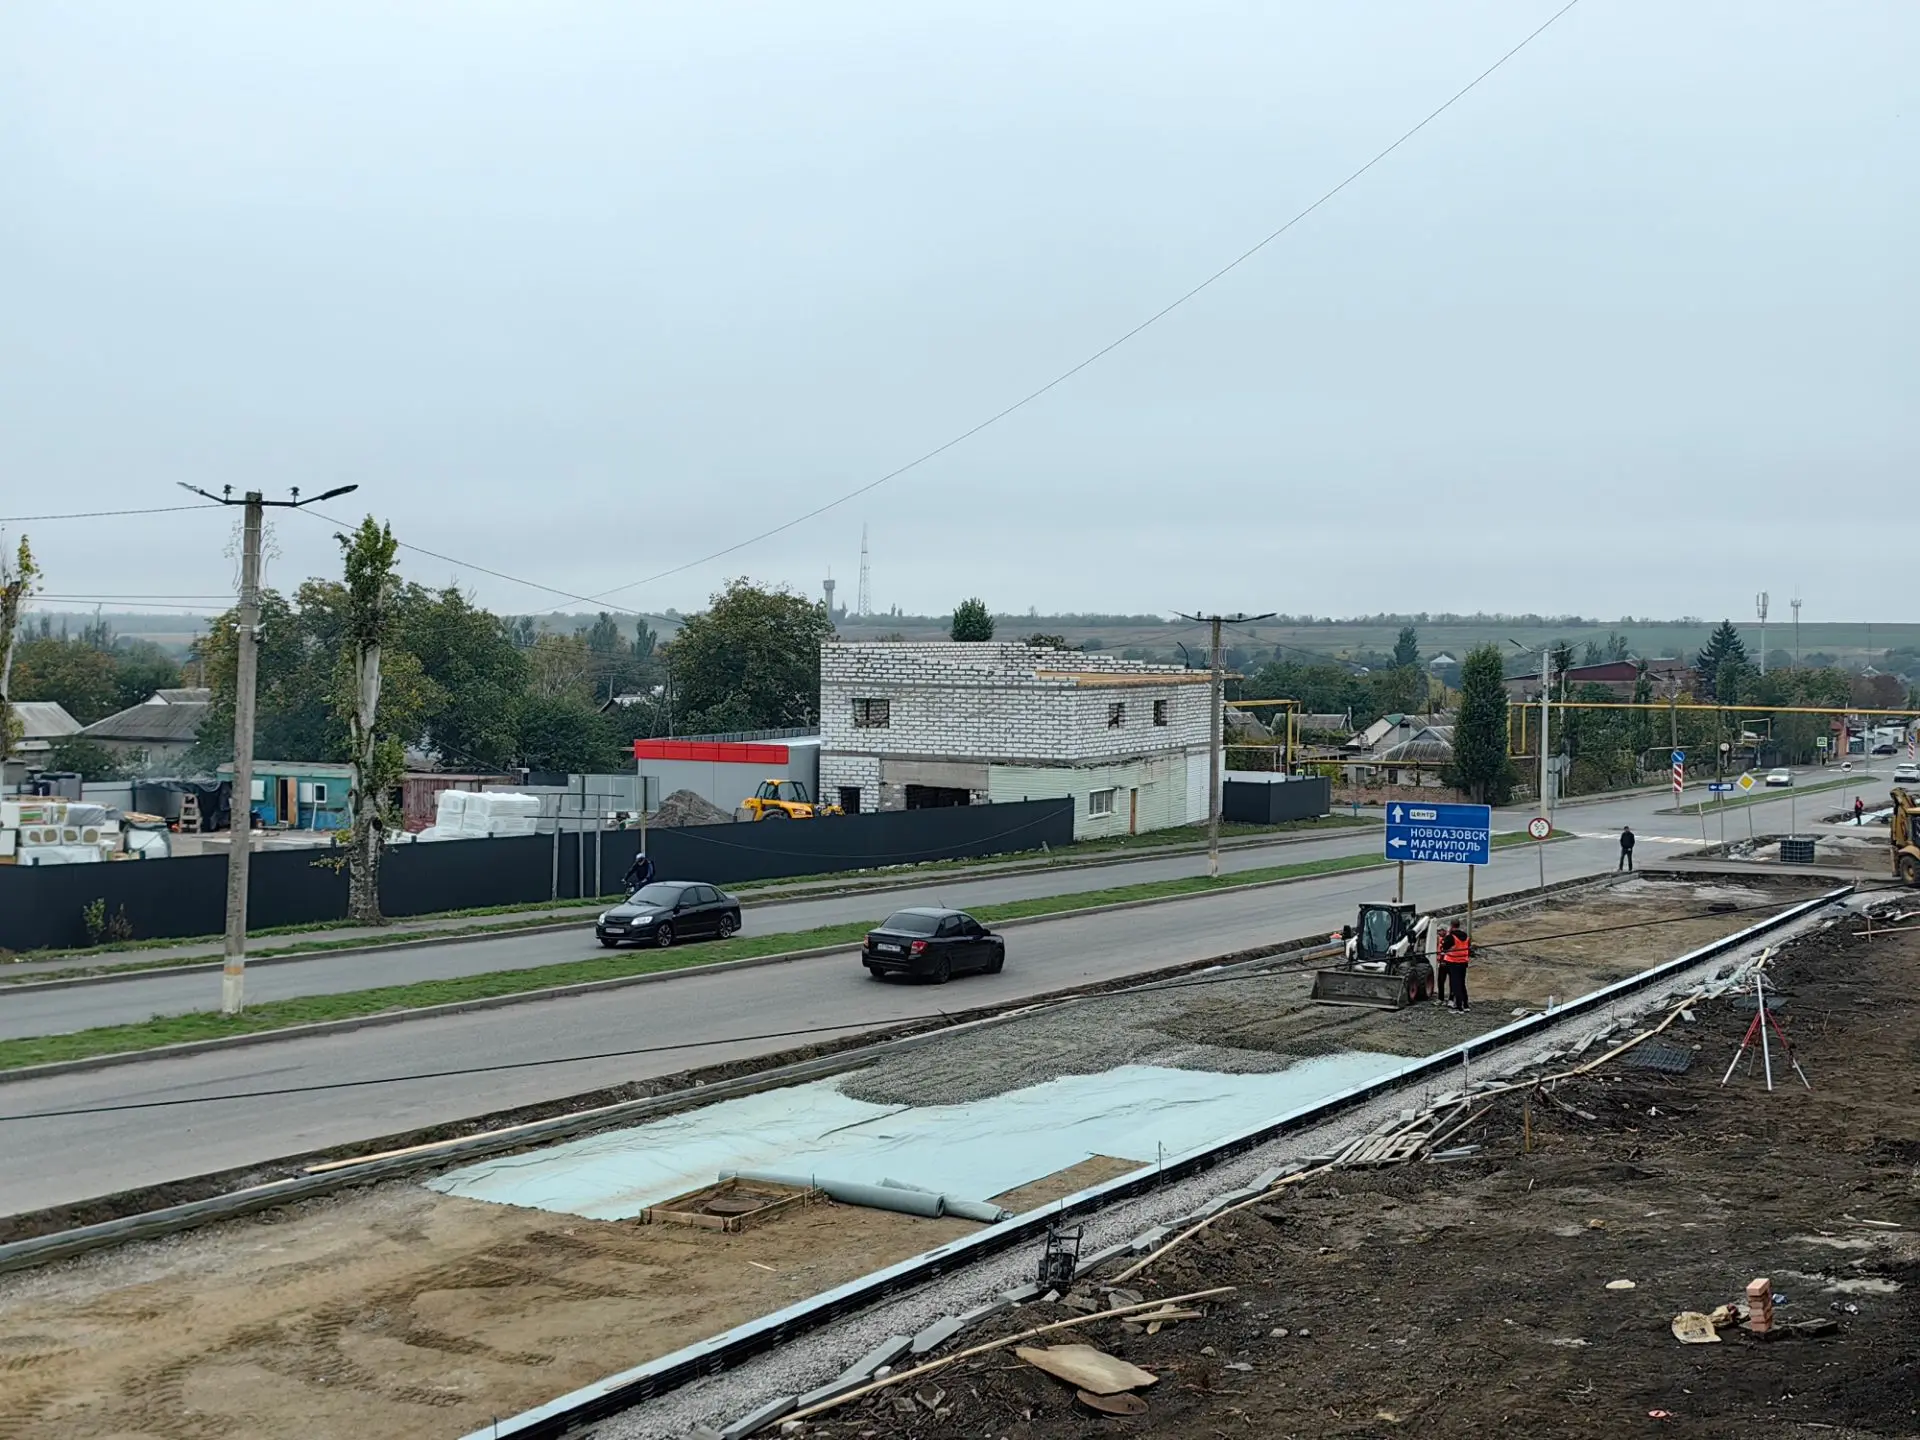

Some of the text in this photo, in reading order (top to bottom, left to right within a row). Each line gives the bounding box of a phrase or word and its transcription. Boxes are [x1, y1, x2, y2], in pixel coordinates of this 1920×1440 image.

[1410, 828, 1487, 841] НОВОАЗОВСК
[1410, 839, 1480, 851] МАРИУПОЛЬ
[1411, 850, 1470, 861] ТАГАНРОГ
